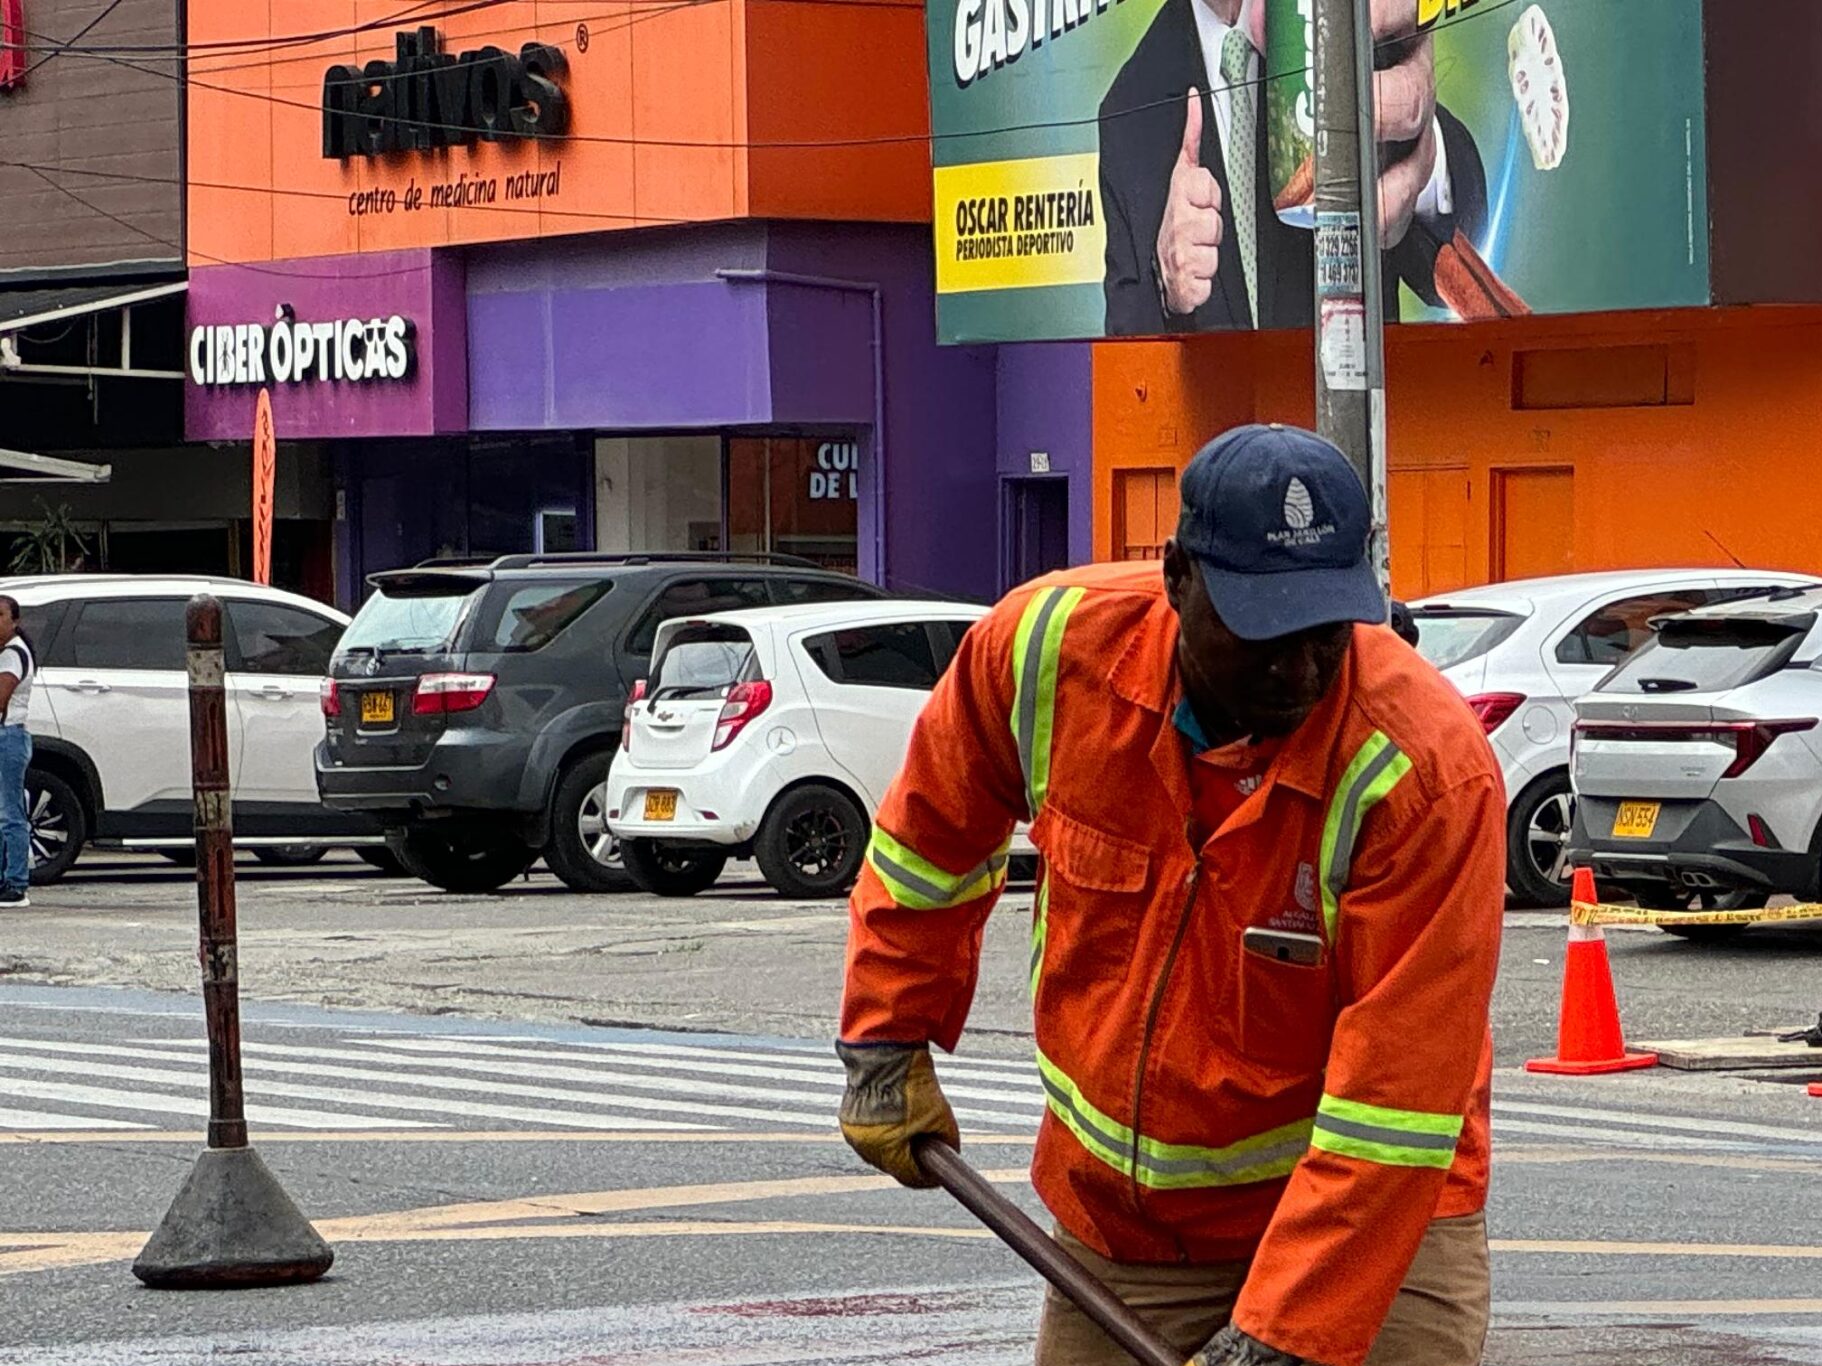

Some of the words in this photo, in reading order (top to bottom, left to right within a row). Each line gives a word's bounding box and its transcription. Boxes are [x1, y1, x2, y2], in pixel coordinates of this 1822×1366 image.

[348, 181, 395, 215] centro
[404, 177, 422, 211] de
[431, 172, 496, 207] medicina
[505, 160, 561, 201] natural
[956, 197, 1009, 237] OSCAR
[1014, 178, 1095, 232] RENTERÍA
[956, 235, 1013, 262] PERIODISTA
[1017, 230, 1074, 256] DEPORTIVO
[190, 323, 266, 385] CIBER
[270, 303, 408, 383] ÓPTICAS
[809, 472, 840, 498] DE
